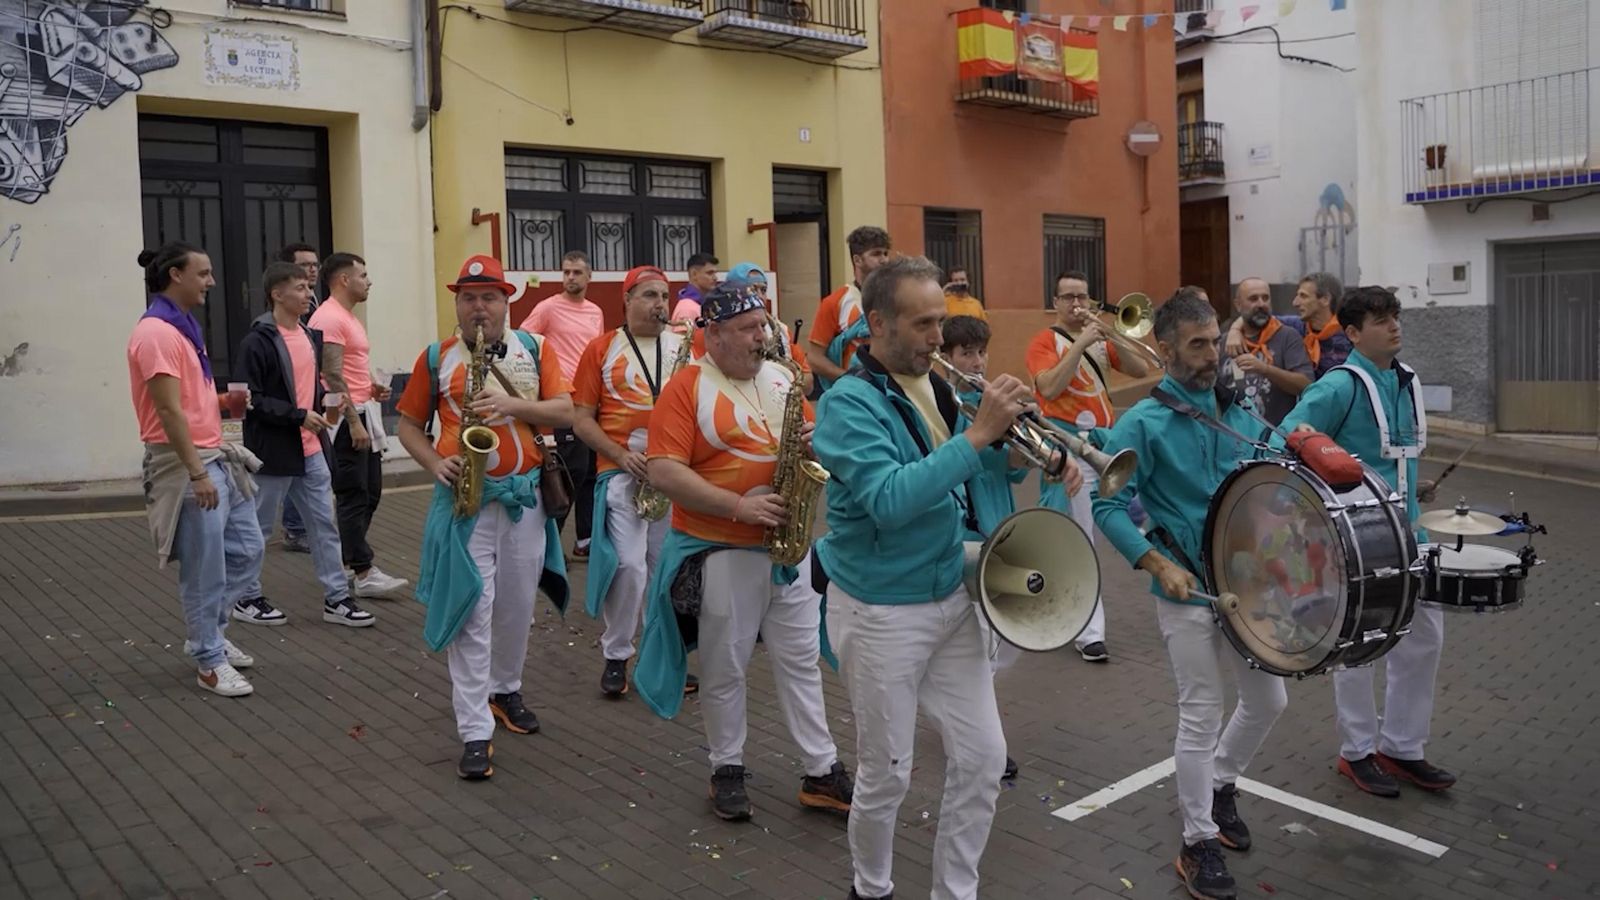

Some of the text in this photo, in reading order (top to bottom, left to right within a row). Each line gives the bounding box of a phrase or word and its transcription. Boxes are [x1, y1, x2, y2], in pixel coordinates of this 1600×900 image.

[245, 49, 281, 59] AGENCIA
[258, 57, 267, 65] DE
[245, 65, 282, 75] LECTURA
